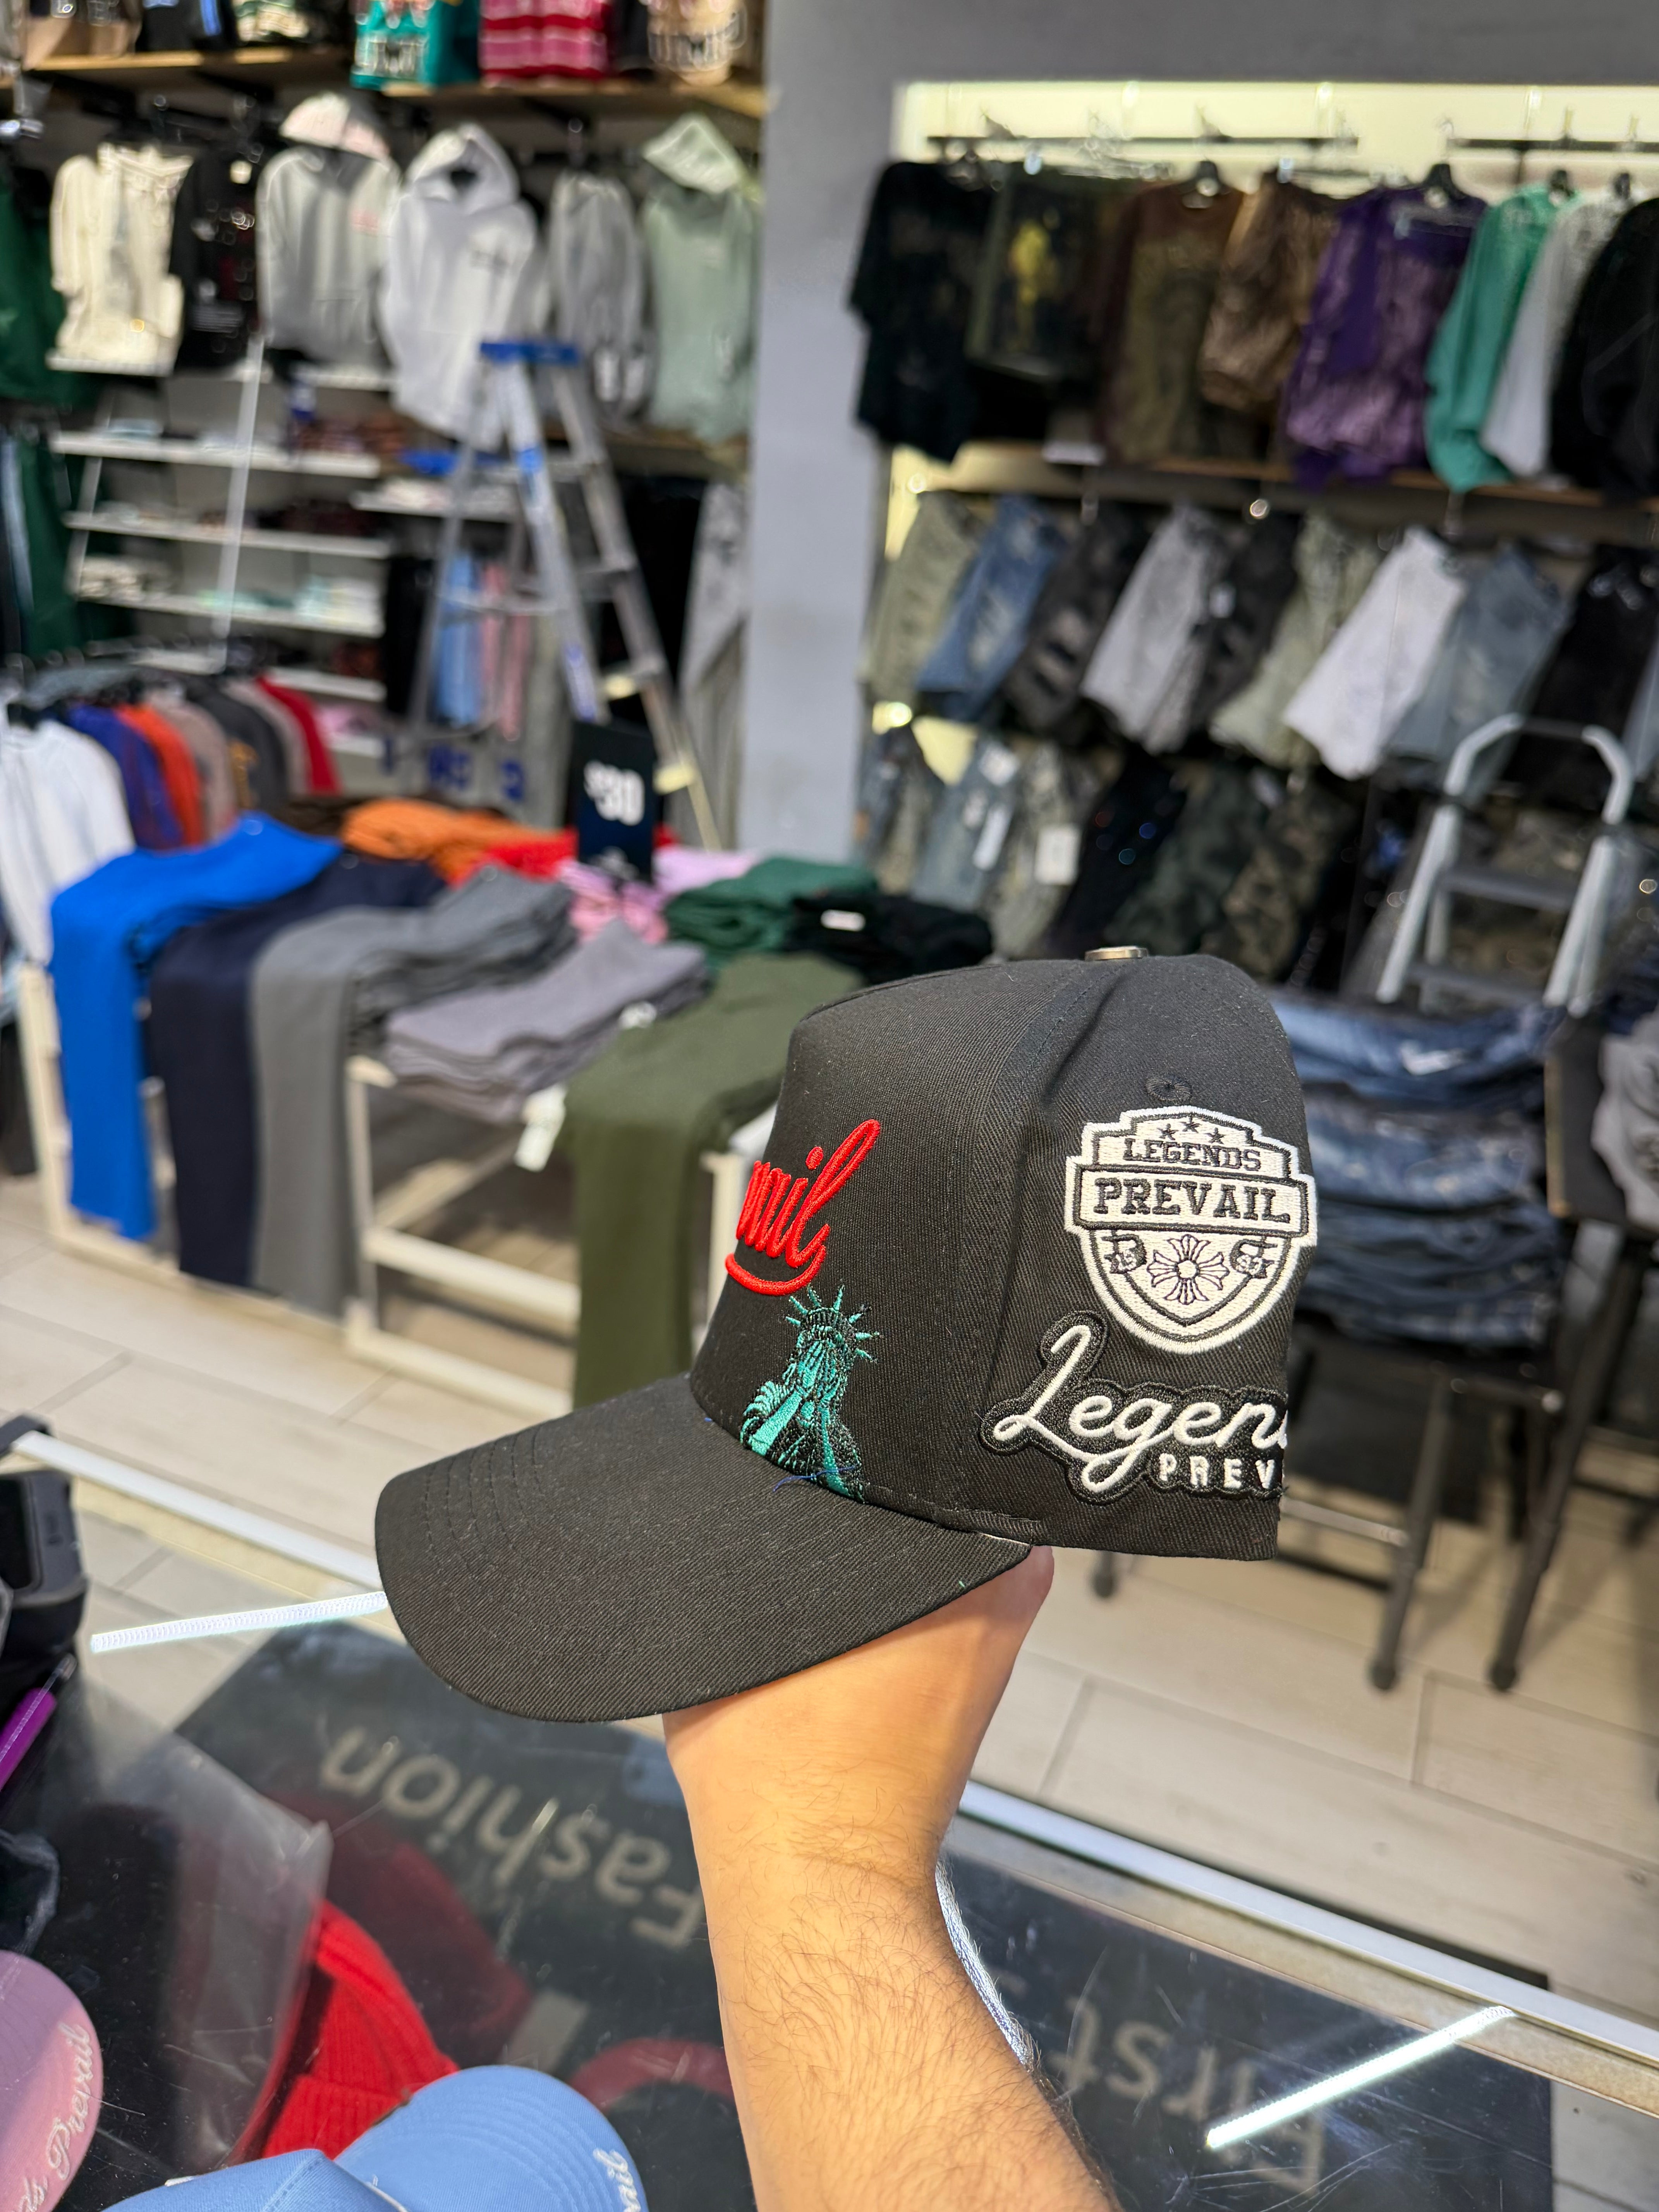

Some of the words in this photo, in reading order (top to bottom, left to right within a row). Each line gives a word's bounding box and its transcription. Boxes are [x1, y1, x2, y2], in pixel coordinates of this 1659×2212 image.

[1092, 1176, 1290, 1224] PREVAIL
[1123, 1137, 1262, 1171] LEGENDS
[320, 1726, 703, 1949] Fashion
[46, 2021, 93, 2181] Prevail
